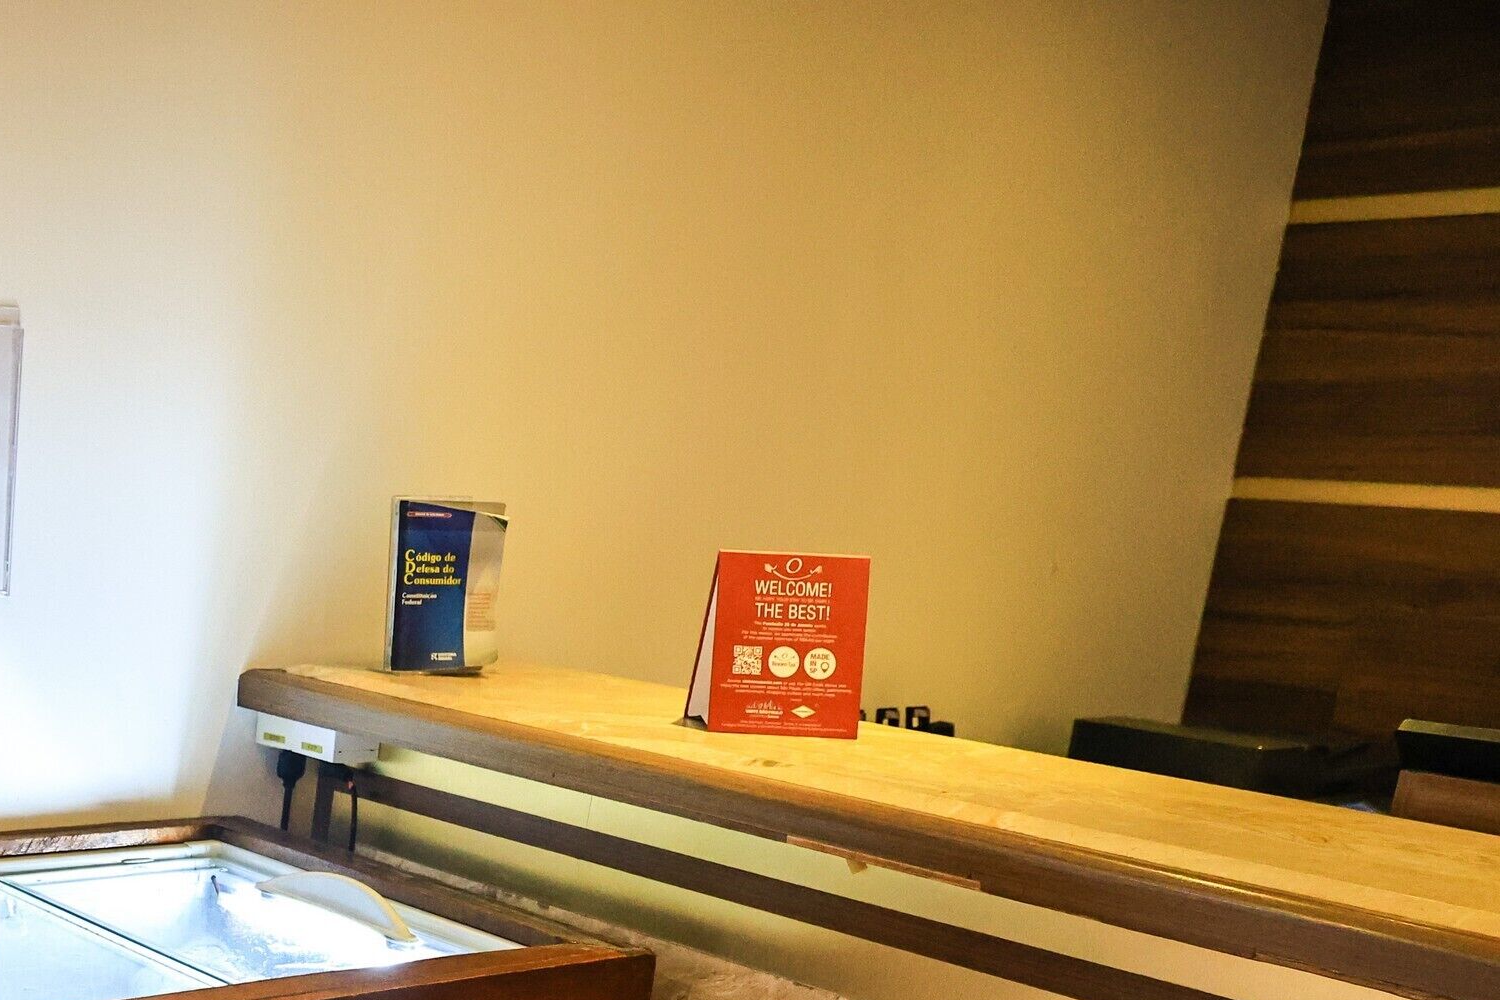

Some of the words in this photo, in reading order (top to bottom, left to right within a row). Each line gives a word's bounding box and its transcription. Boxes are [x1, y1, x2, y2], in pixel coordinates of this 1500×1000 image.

[405, 549, 442, 564] Código
[444, 552, 456, 562] de
[405, 561, 440, 573] Defesa
[443, 564, 455, 573] do
[404, 572, 461, 585] Consumidor
[755, 580, 833, 598] WELCOME!
[755, 602, 783, 619] THE
[788, 604, 831, 621] BEST!
